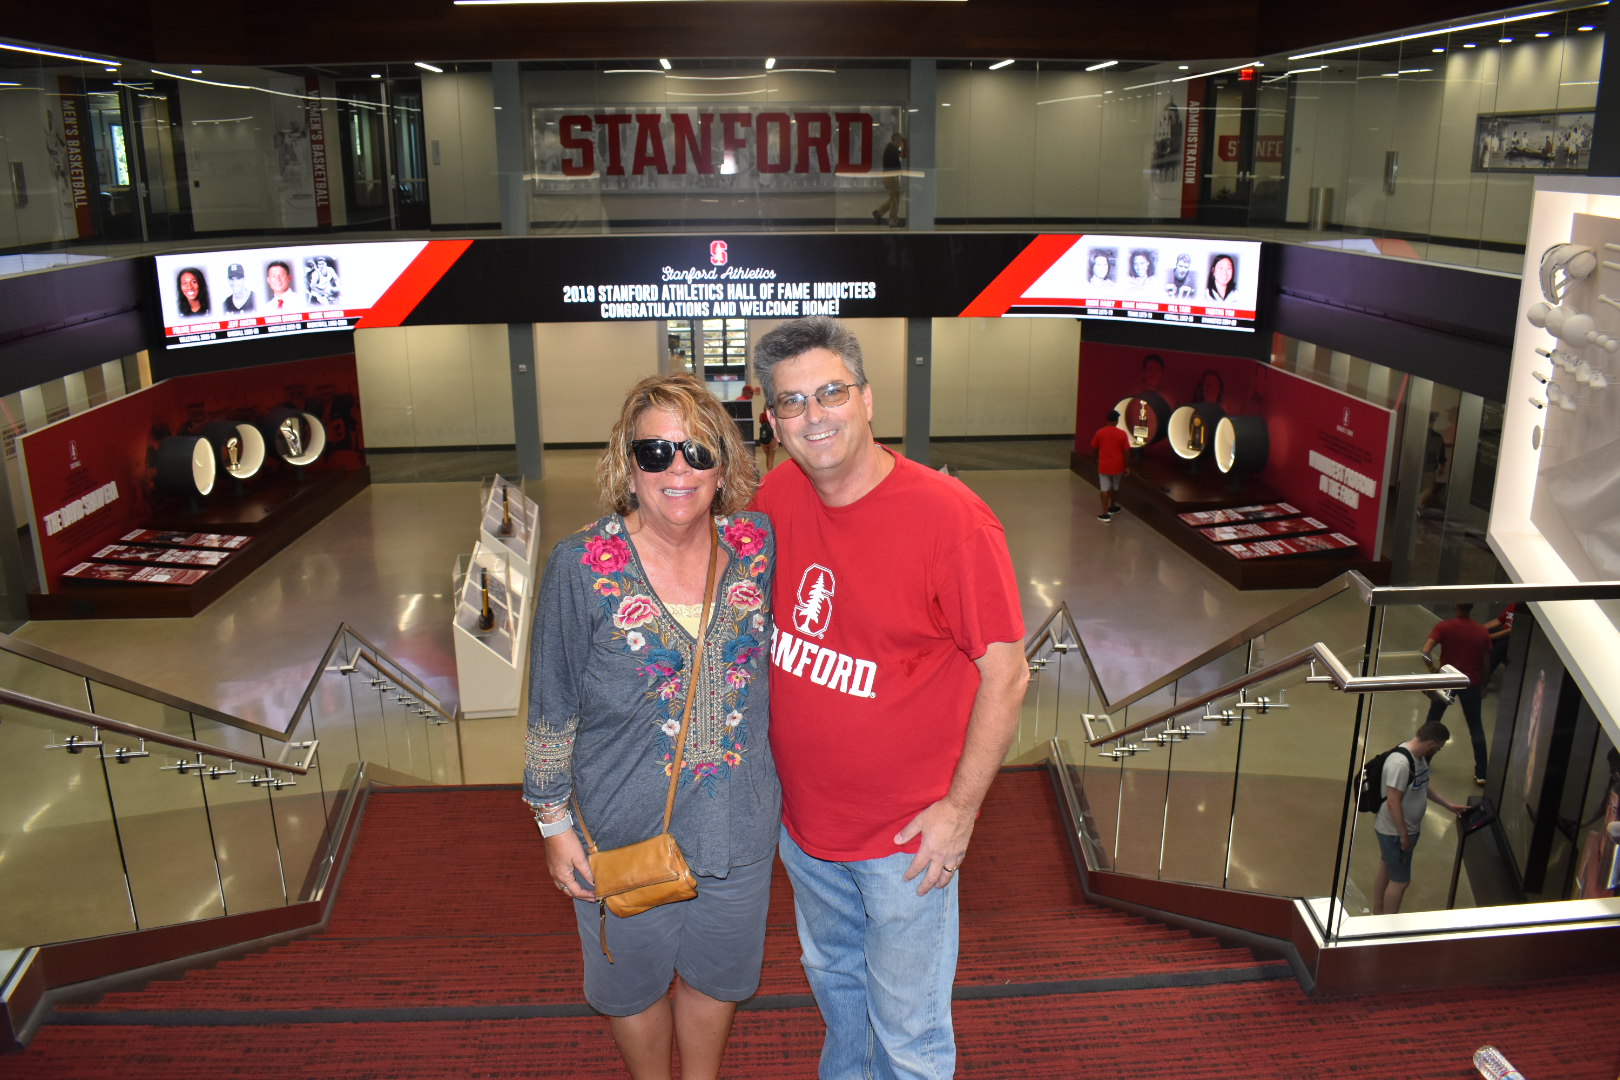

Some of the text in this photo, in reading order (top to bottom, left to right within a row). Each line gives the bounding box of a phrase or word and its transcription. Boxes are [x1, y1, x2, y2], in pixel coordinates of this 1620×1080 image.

[62, 100, 88, 209] MEN'S BASKETBALL
[559, 112, 873, 176] STANFORD
[1185, 100, 1200, 185] ADMINISTRATION
[311, 143, 329, 208] BASKETBALL
[562, 282, 876, 303] 2019 STANFORD ATHLETICS HALL OF FAME INDUCTEES
[661, 265, 776, 284] Stanford Athletics
[600, 299, 840, 318] CONGRATULATIONS AND WELCOME HOME!
